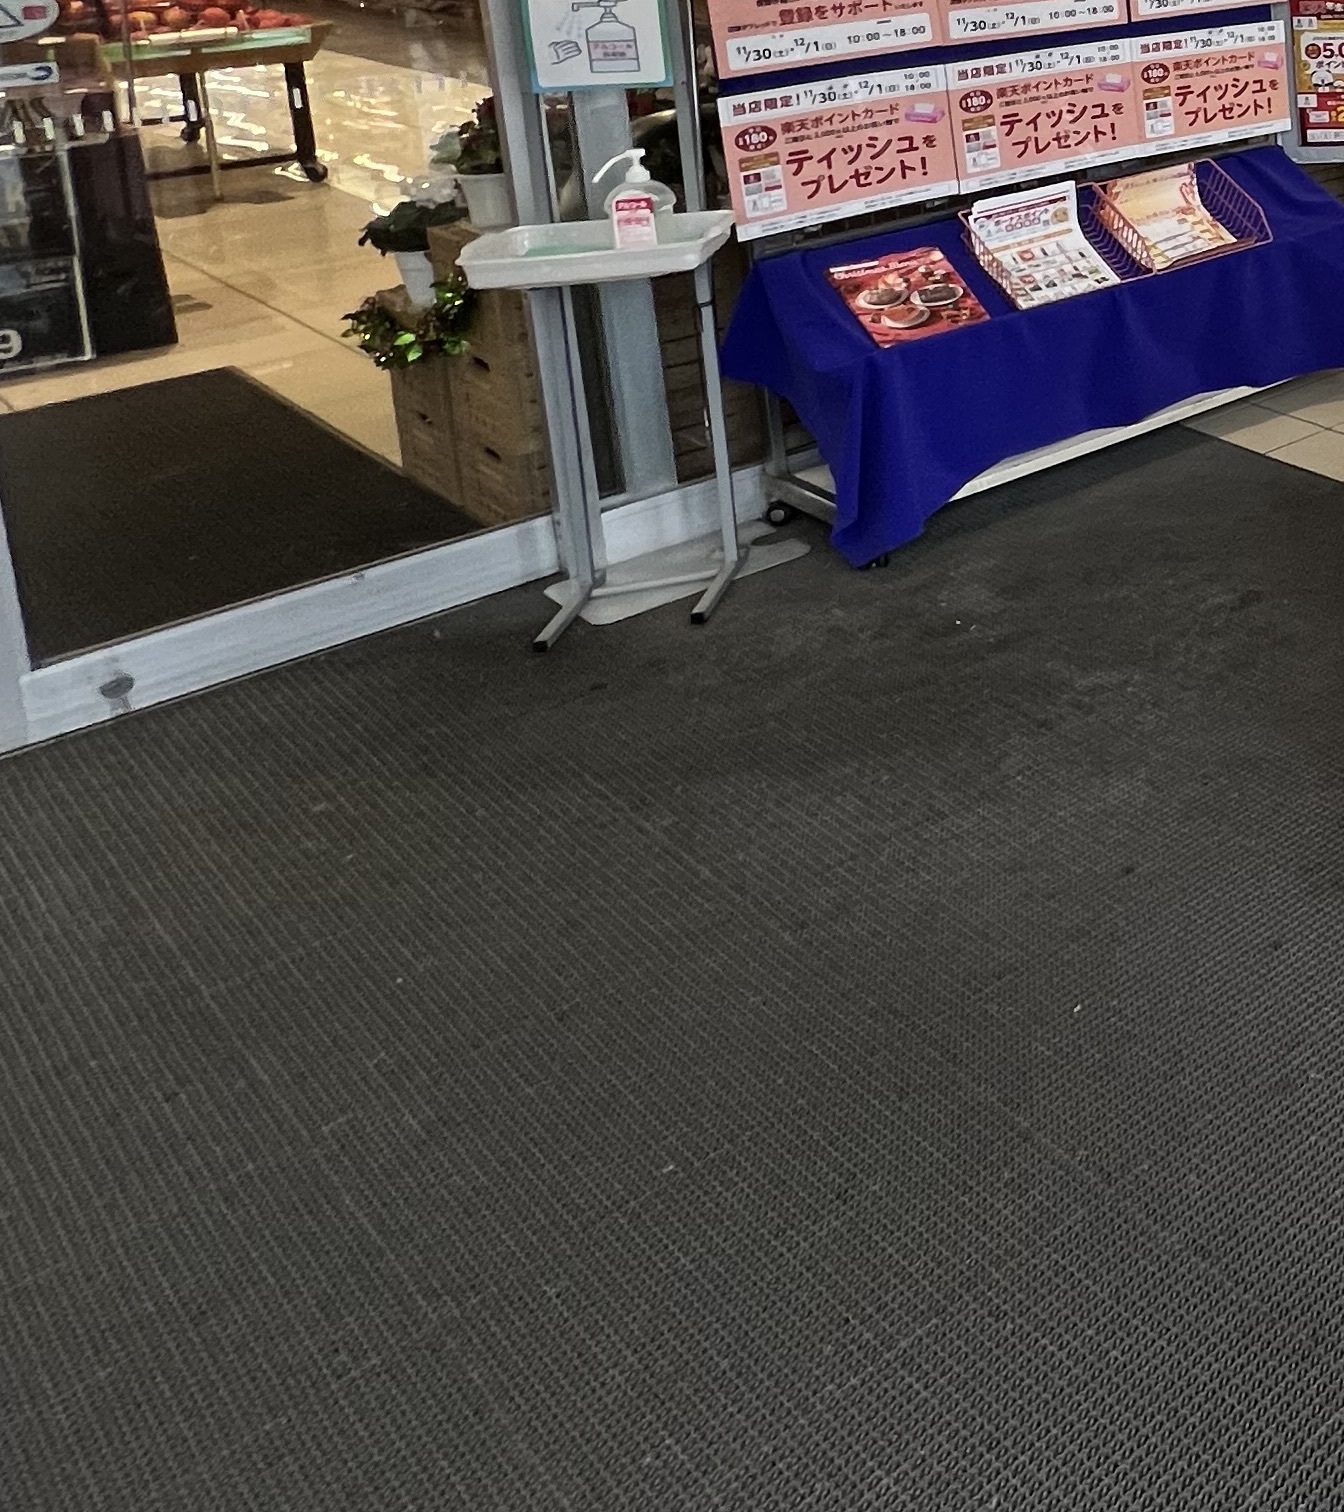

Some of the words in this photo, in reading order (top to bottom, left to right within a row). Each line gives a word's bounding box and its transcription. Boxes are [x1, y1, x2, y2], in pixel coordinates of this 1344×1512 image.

[1174, 77, 1279, 107] ティッシュを
[780, 102, 900, 134] 楽天ポイントカード
[1000, 101, 1125, 137] ティッシュを
[1184, 97, 1272, 128] プレゼント!
[786, 134, 937, 177] ティッシュを
[1011, 122, 1117, 159] プレゼント!
[800, 156, 928, 200] プレゼント!
